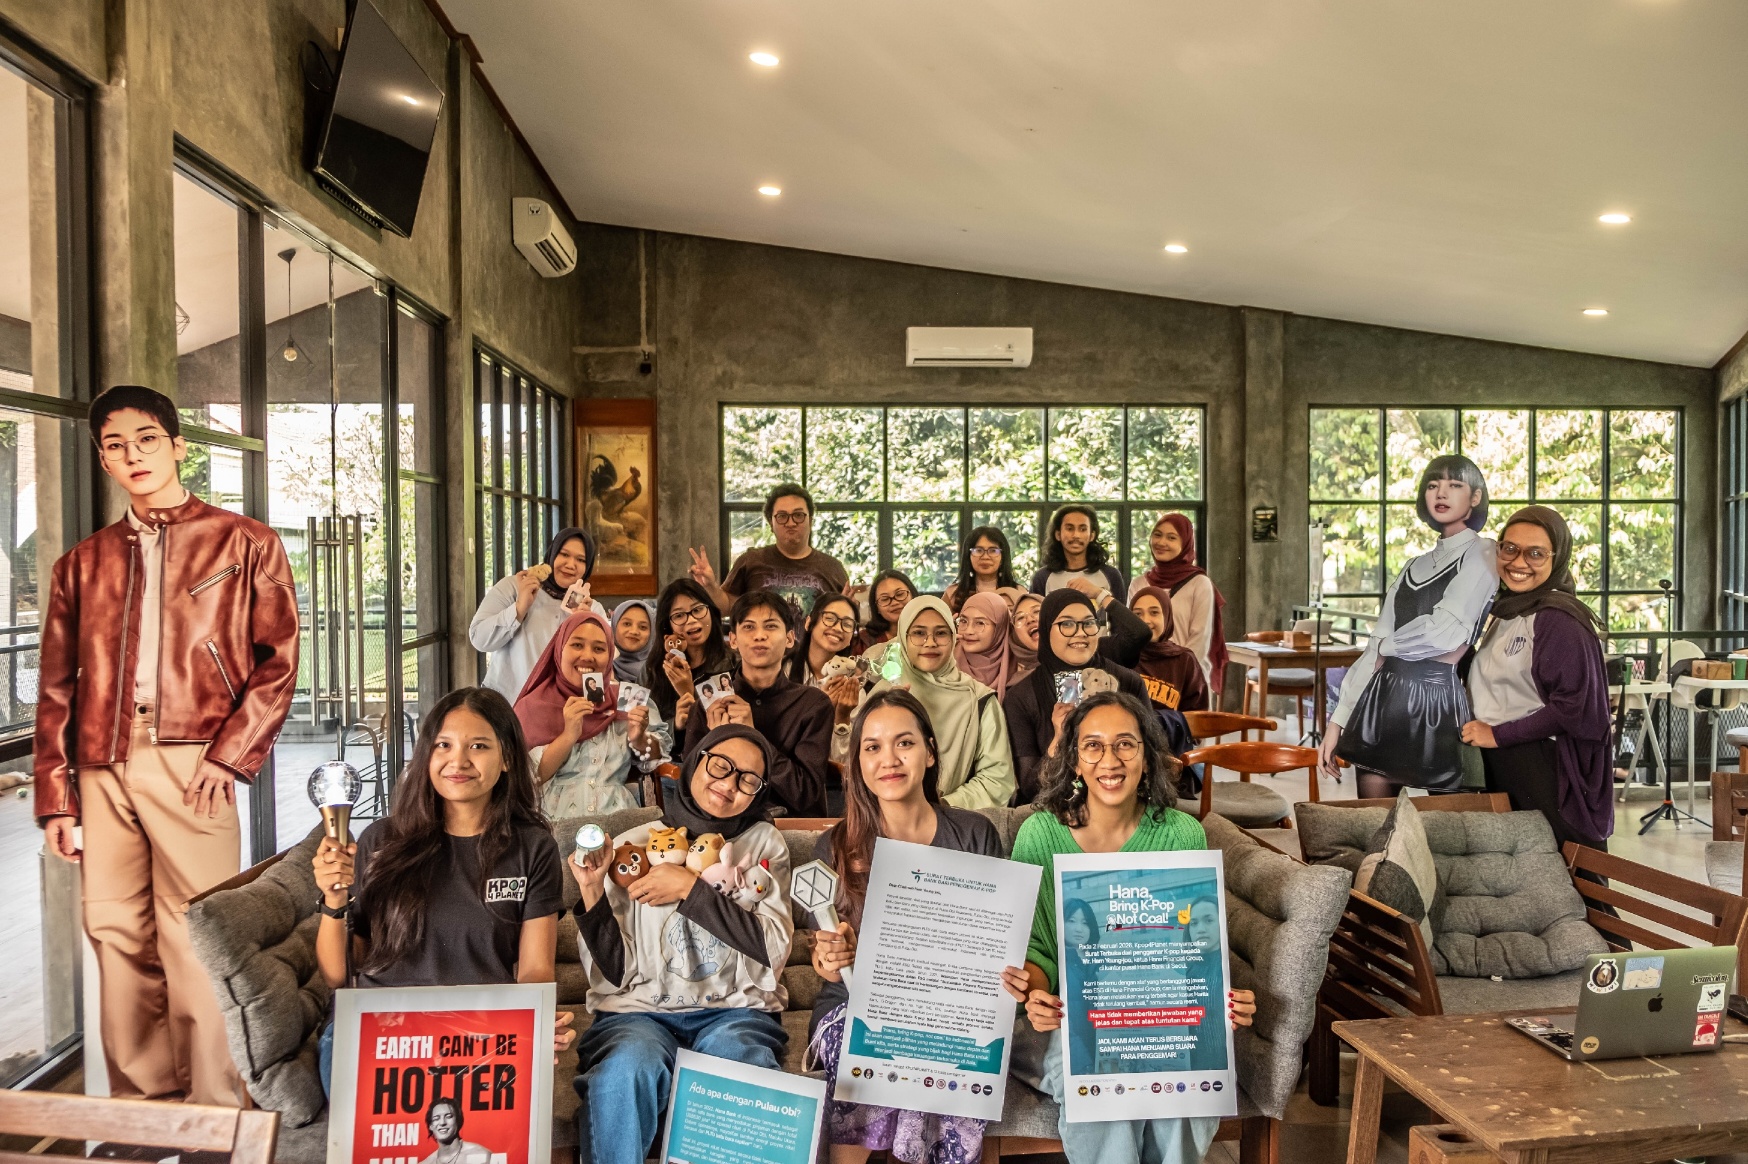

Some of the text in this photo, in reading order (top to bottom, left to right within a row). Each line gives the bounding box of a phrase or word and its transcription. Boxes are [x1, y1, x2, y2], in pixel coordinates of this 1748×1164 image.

[488, 880, 526, 893] KPOP
[1109, 884, 1153, 900] Hana,
[1110, 900, 1174, 914] Bring K-Pop
[1117, 912, 1168, 924] Not Coal!
[1117, 978, 1136, 986] dengan
[1161, 1008, 1186, 1017] jawaban
[1095, 1019, 1110, 1027] jelas
[1165, 1034, 1197, 1042] BERSUARA
[375, 1034, 517, 1060] EARTH CAN'T BE
[372, 1064, 518, 1114] HOTTER
[689, 1082, 801, 1118] Ada apa dengan Pulau Obi?
[371, 1122, 420, 1147] THAN
